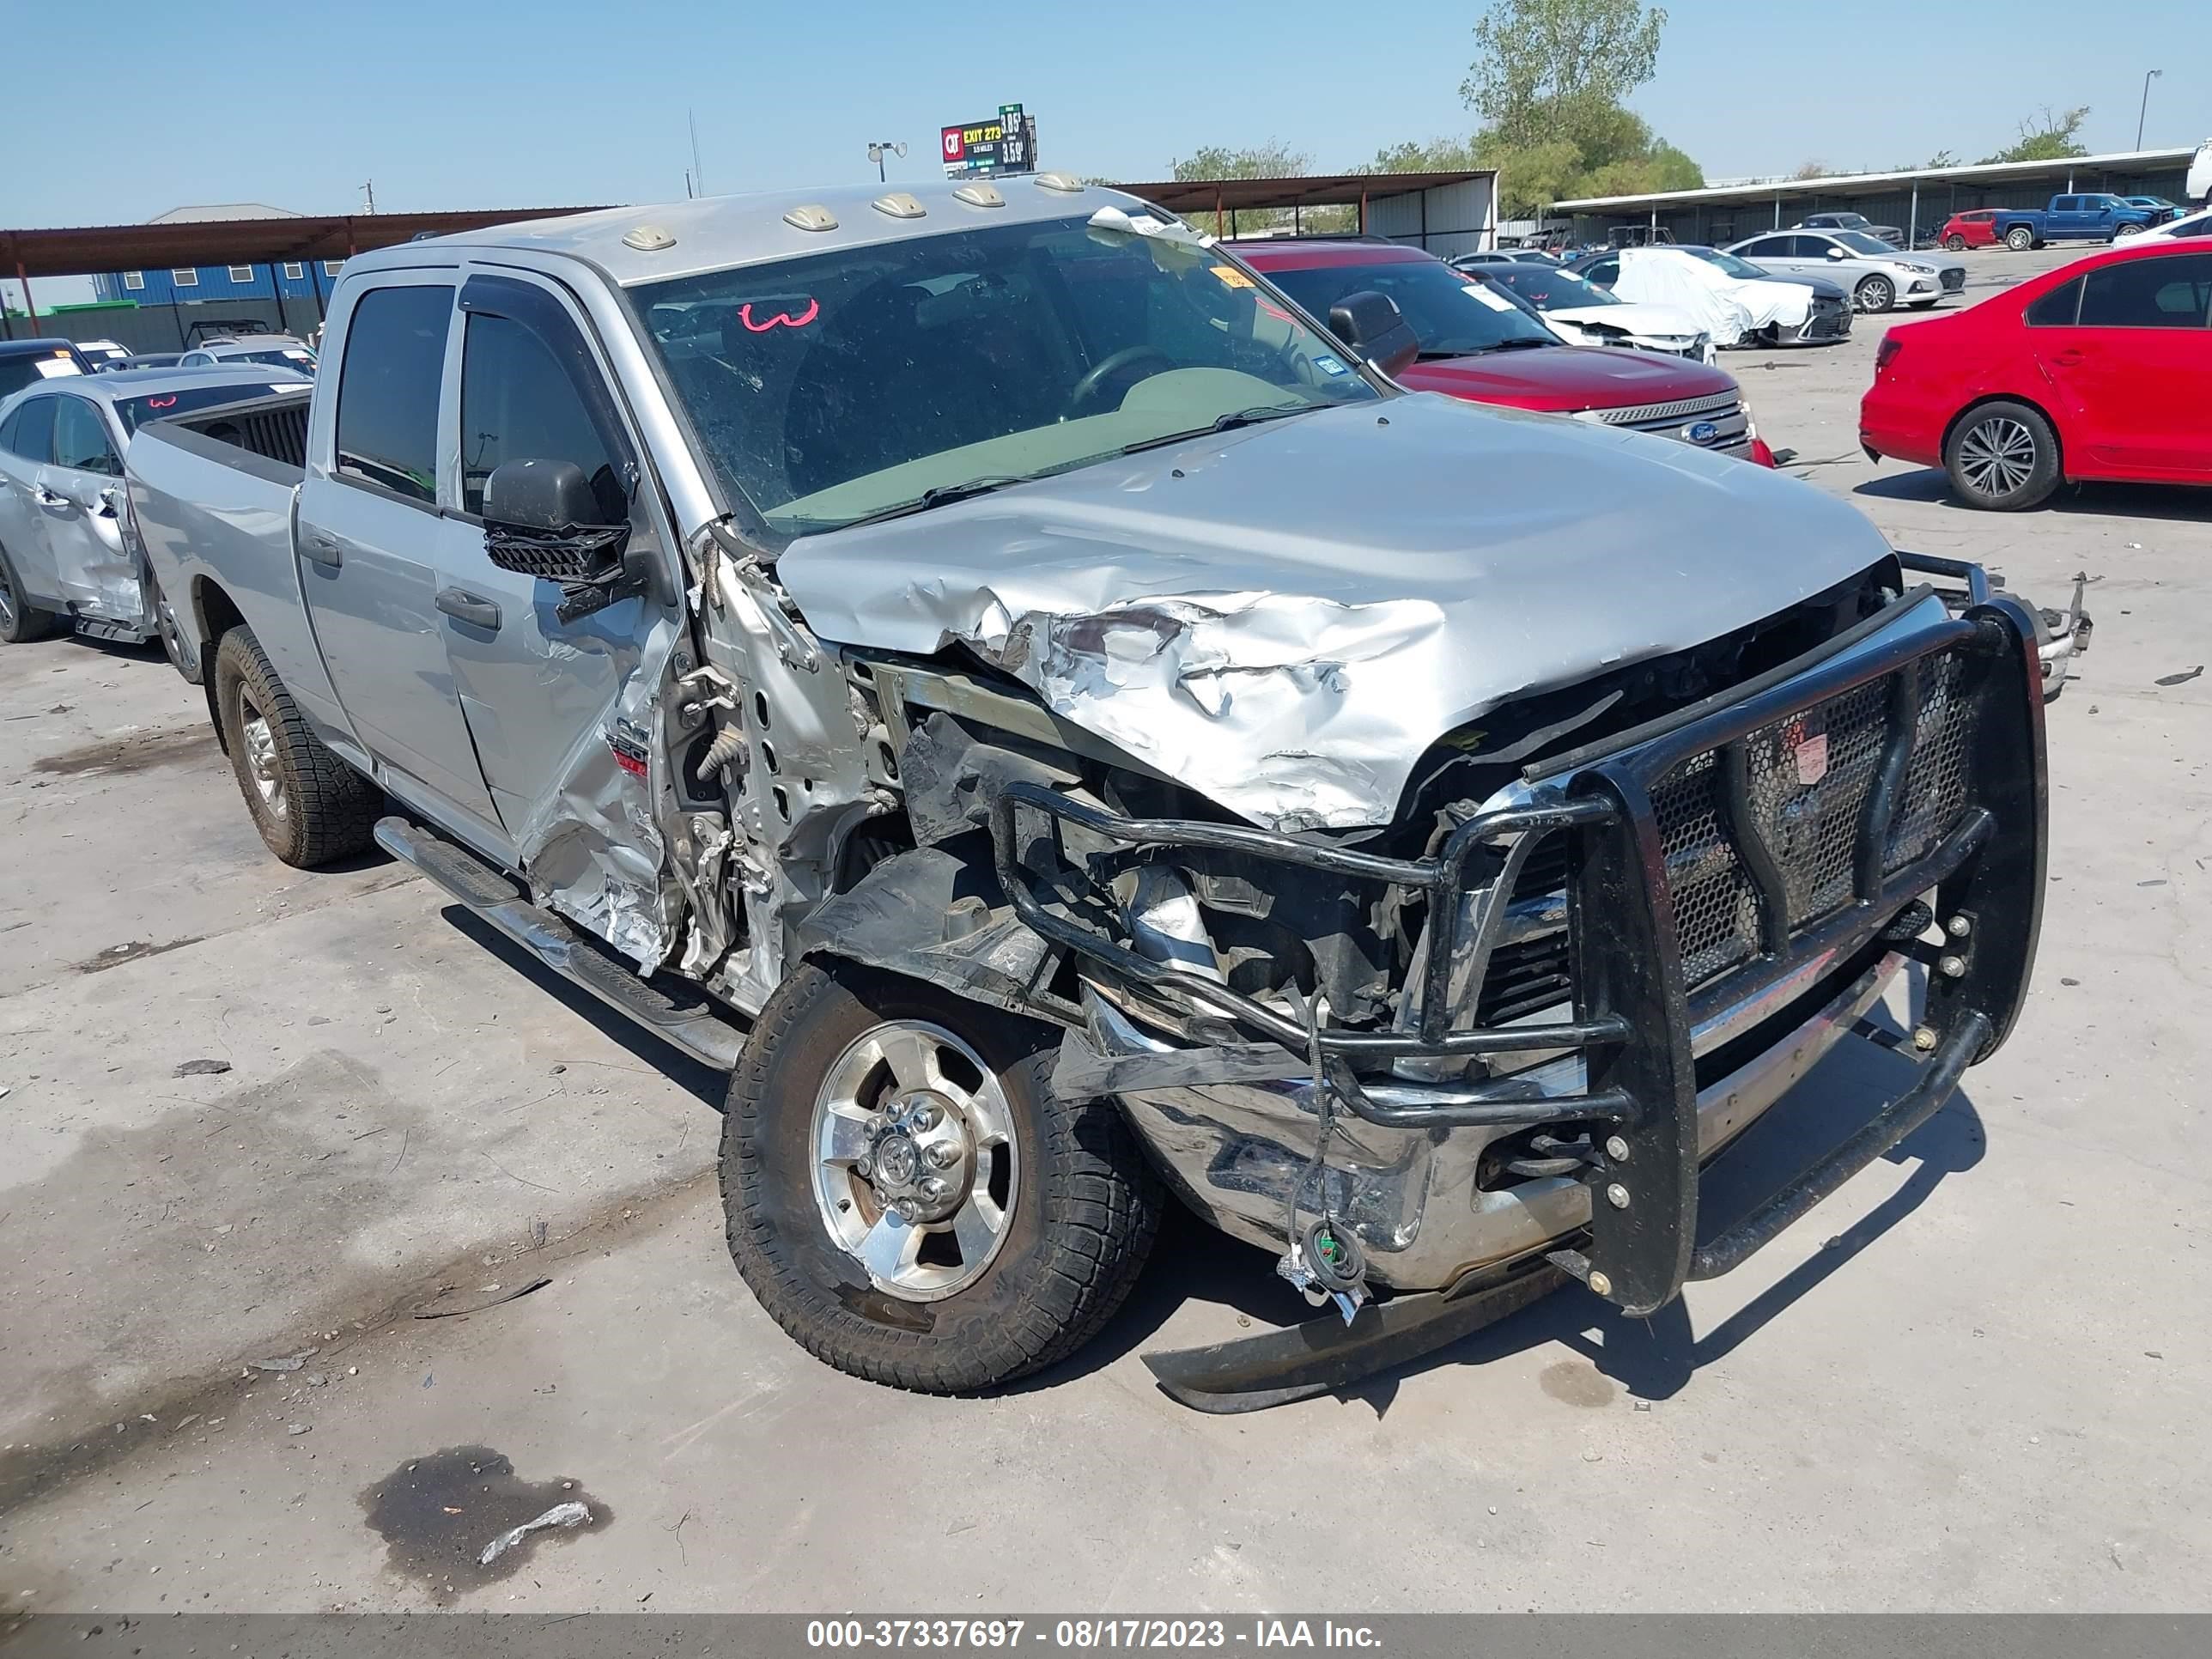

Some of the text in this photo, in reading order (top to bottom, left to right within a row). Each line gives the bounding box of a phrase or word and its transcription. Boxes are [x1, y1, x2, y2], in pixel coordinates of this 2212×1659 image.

[945, 133, 959, 155] QT
[963, 130, 982, 144] EXIT
[985, 126, 1001, 141] 273
